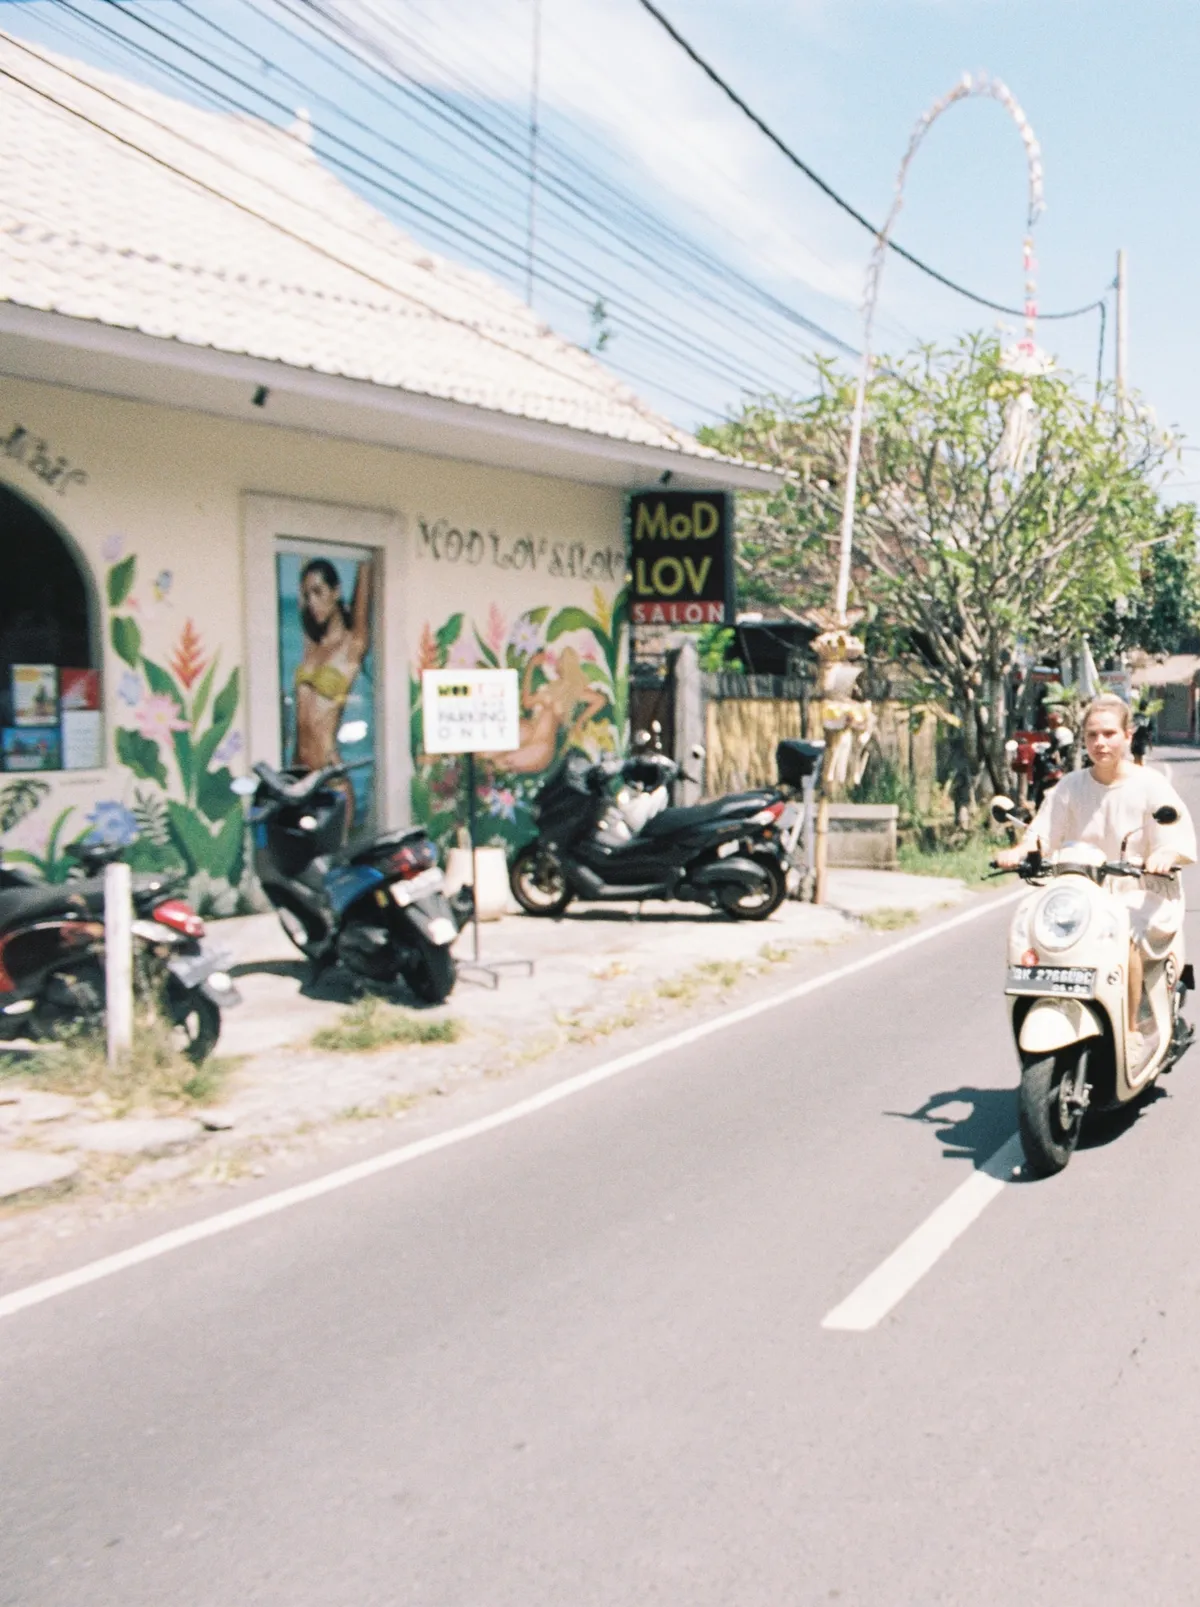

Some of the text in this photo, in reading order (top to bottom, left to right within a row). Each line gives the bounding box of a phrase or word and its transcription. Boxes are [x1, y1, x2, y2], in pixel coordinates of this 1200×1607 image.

[636, 502, 719, 539] MoD
[636, 556, 712, 595] LOV
[633, 603, 725, 623] SALON
